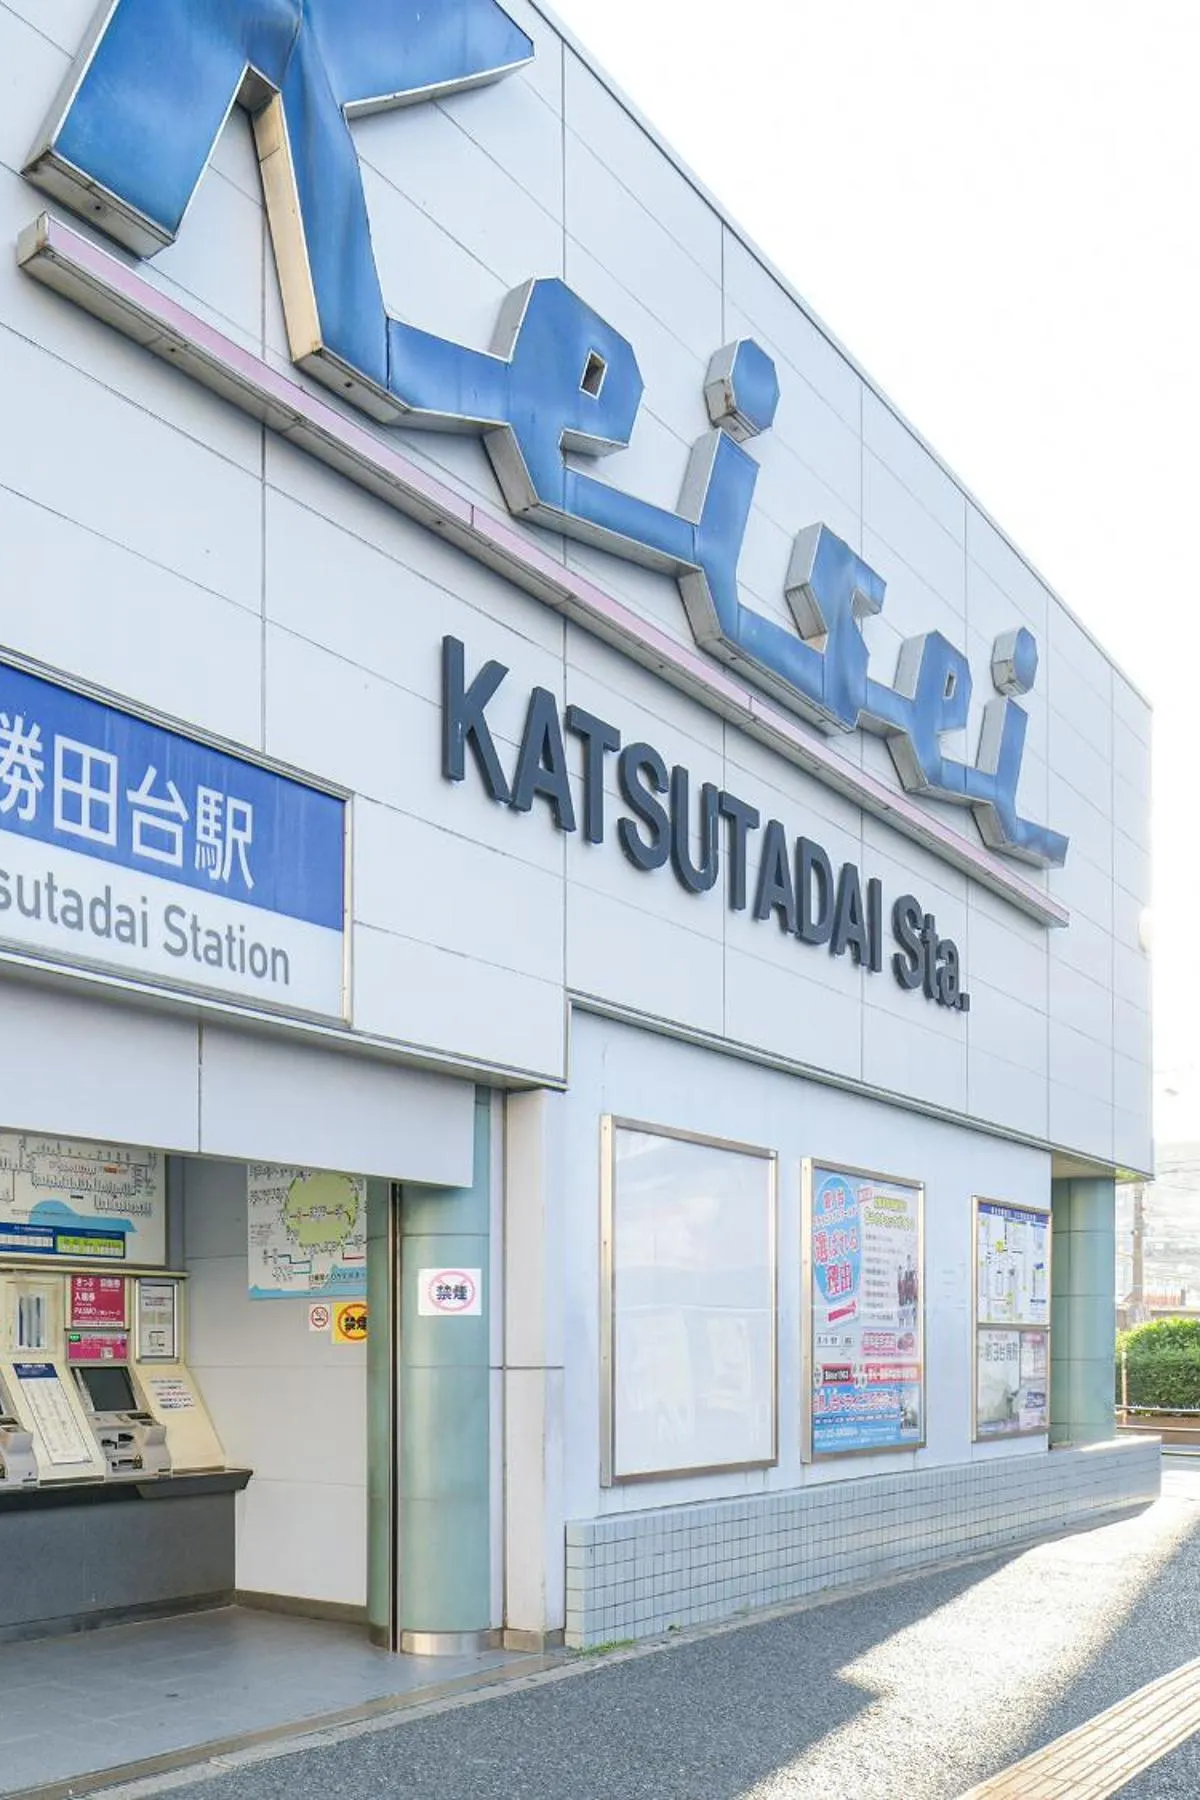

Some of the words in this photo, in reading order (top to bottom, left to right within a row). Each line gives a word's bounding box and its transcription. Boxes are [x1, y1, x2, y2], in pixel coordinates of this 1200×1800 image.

[440, 634, 883, 972] KATSUTADAI
[890, 893, 971, 1012] Sta.
[163, 904, 291, 986] Station
[436, 1284, 468, 1301] 禁煙
